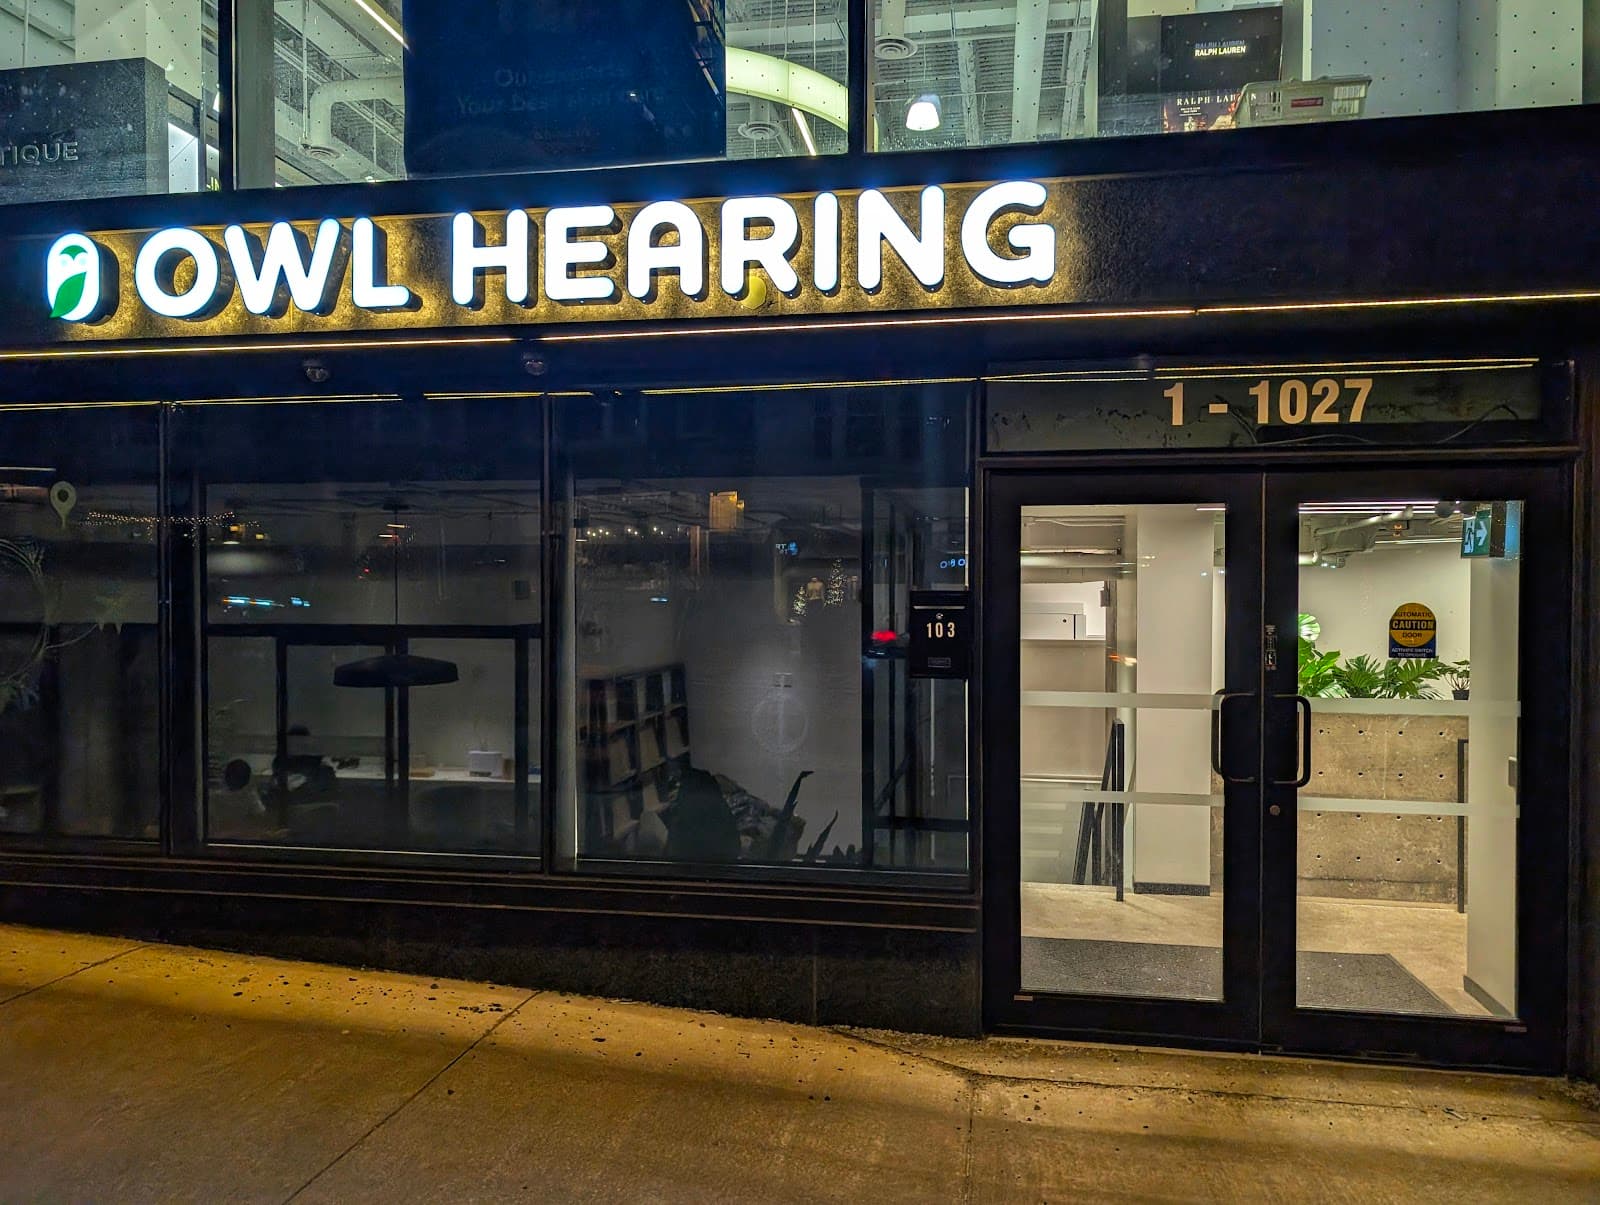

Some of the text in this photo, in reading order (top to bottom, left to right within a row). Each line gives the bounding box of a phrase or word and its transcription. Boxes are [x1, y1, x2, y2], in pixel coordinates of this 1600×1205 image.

[1194, 46, 1246, 57] RALPH LAUREN
[1176, 93, 1257, 106] RALPH LAUN
[135, 181, 1056, 317] OWL HEARING
[1163, 382, 1184, 426] 1
[1249, 378, 1373, 425] 1027
[926, 622, 956, 639] 103
[1392, 620, 1434, 629] CAUTION
